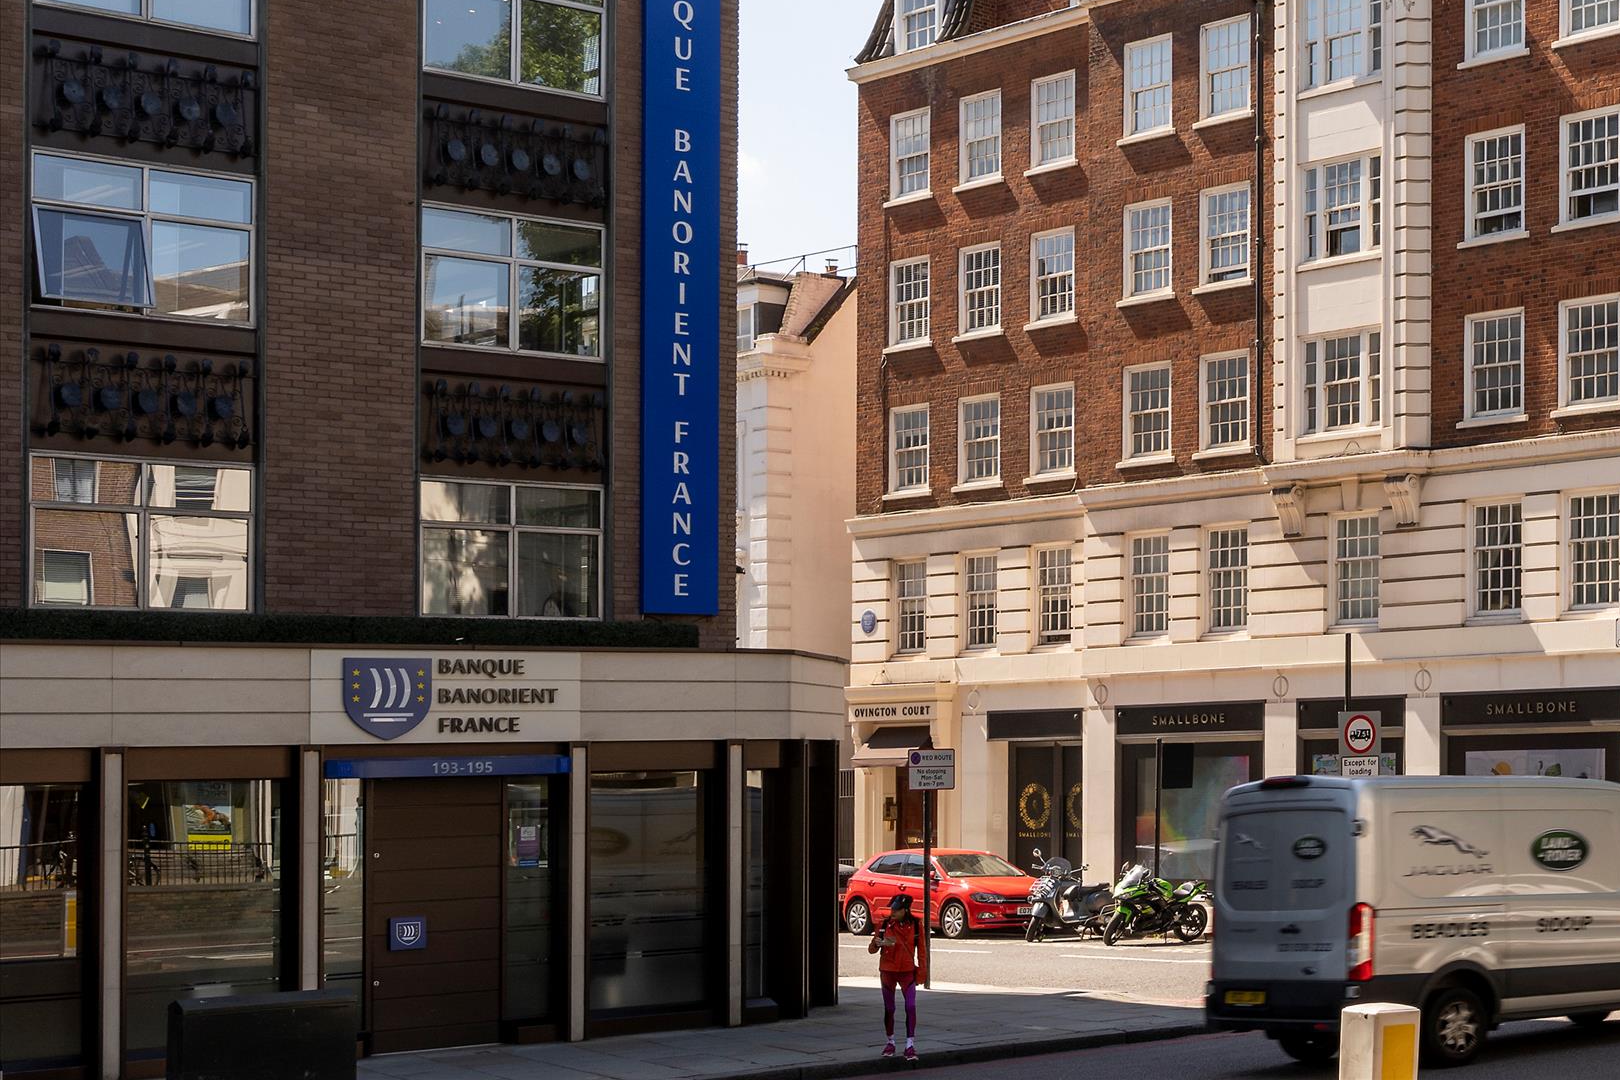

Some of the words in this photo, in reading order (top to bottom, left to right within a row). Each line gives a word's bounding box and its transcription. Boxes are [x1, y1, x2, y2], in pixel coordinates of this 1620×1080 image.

[672, 129, 693, 396] BANORIENT
[672, 421, 692, 596] FRANCE
[437, 658, 525, 678] BANQUE
[437, 688, 558, 704] BANORIENT
[854, 707, 897, 718] OVINGTON
[902, 705, 931, 716] COURT
[1486, 701, 1576, 715] SMALLBONE
[437, 717, 520, 733] FRANCE
[1152, 713, 1225, 726] SMALLBONE
[431, 761, 494, 774] 193-195
[1343, 759, 1366, 767] Except
[1367, 758, 1377, 766] for
[1348, 768, 1372, 776] loading
[1403, 863, 1495, 877] JAGUAR
[1411, 921, 1490, 939] BEADLES
